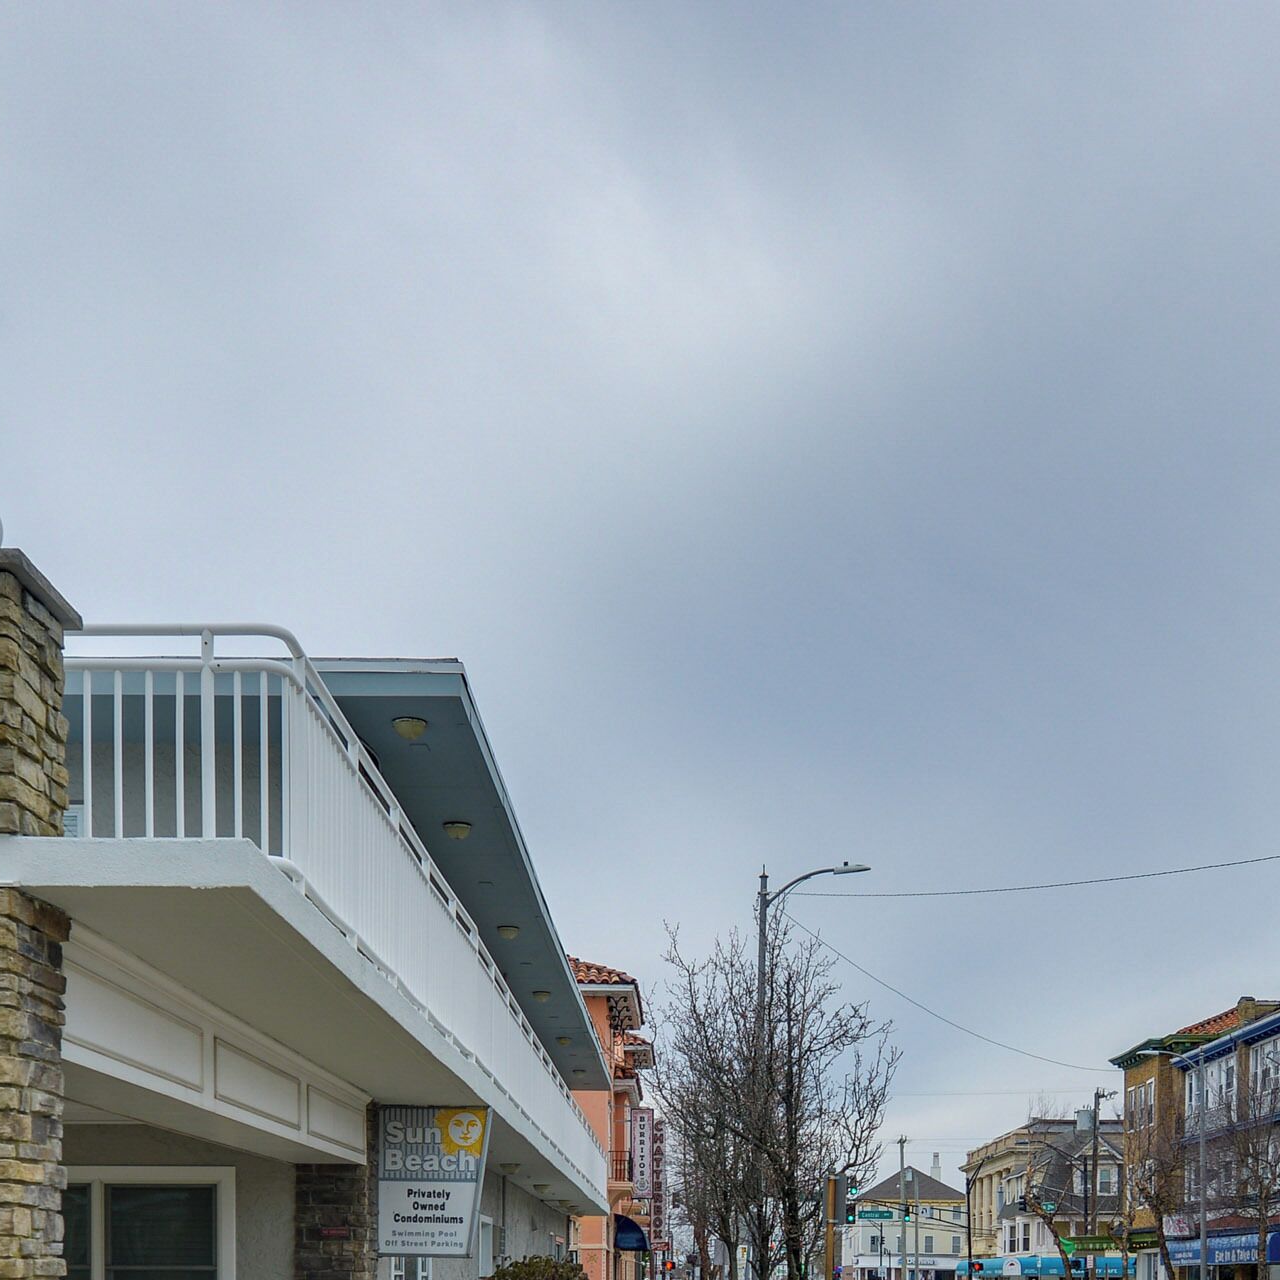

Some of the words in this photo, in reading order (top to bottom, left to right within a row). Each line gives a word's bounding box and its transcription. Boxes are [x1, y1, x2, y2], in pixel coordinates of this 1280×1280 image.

[385, 1121, 441, 1144] Sun
[384, 1149, 475, 1172] Beach
[653, 1120, 664, 1239] CHATTERBOX
[407, 1189, 451, 1200] Privately
[412, 1202, 446, 1211] Owned
[393, 1213, 464, 1224] Condominiums
[392, 1230, 435, 1238] Swimming
